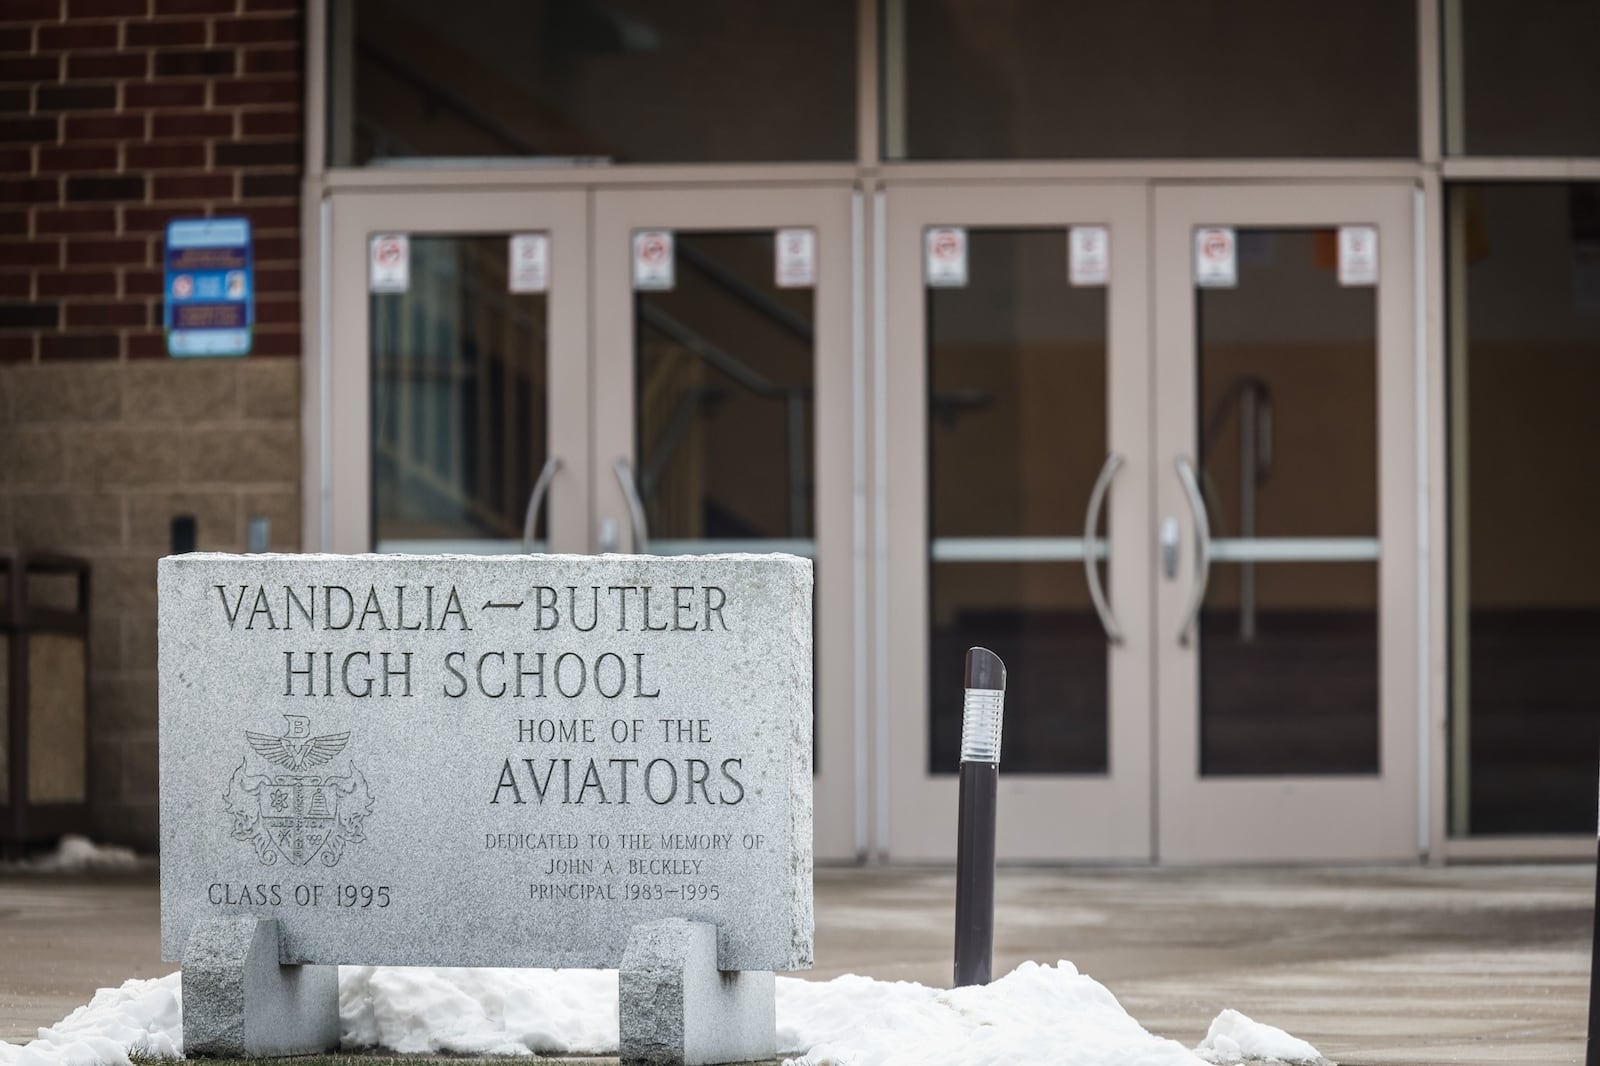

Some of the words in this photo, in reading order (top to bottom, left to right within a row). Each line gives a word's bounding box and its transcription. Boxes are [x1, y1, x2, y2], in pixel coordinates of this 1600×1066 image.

[281, 650, 414, 700] HIGH
[442, 650, 662, 700] SCHOOL
[517, 718, 596, 744] HOME
[611, 718, 645, 744] OF
[659, 718, 712, 744] THE
[489, 757, 745, 806] AVIATORS
[484, 833, 579, 850] DEDICATED
[588, 833, 611, 850] TO
[618, 833, 652, 850] THE
[660, 833, 733, 850] MEMORY
[742, 833, 766, 850] OF
[544, 858, 594, 876] JOHN
[628, 858, 704, 876] BECKLEY
[207, 882, 283, 907] CLASS
[294, 884, 325, 907] OF
[336, 884, 392, 908] 1995
[529, 883, 616, 901] PRINCIPAL
